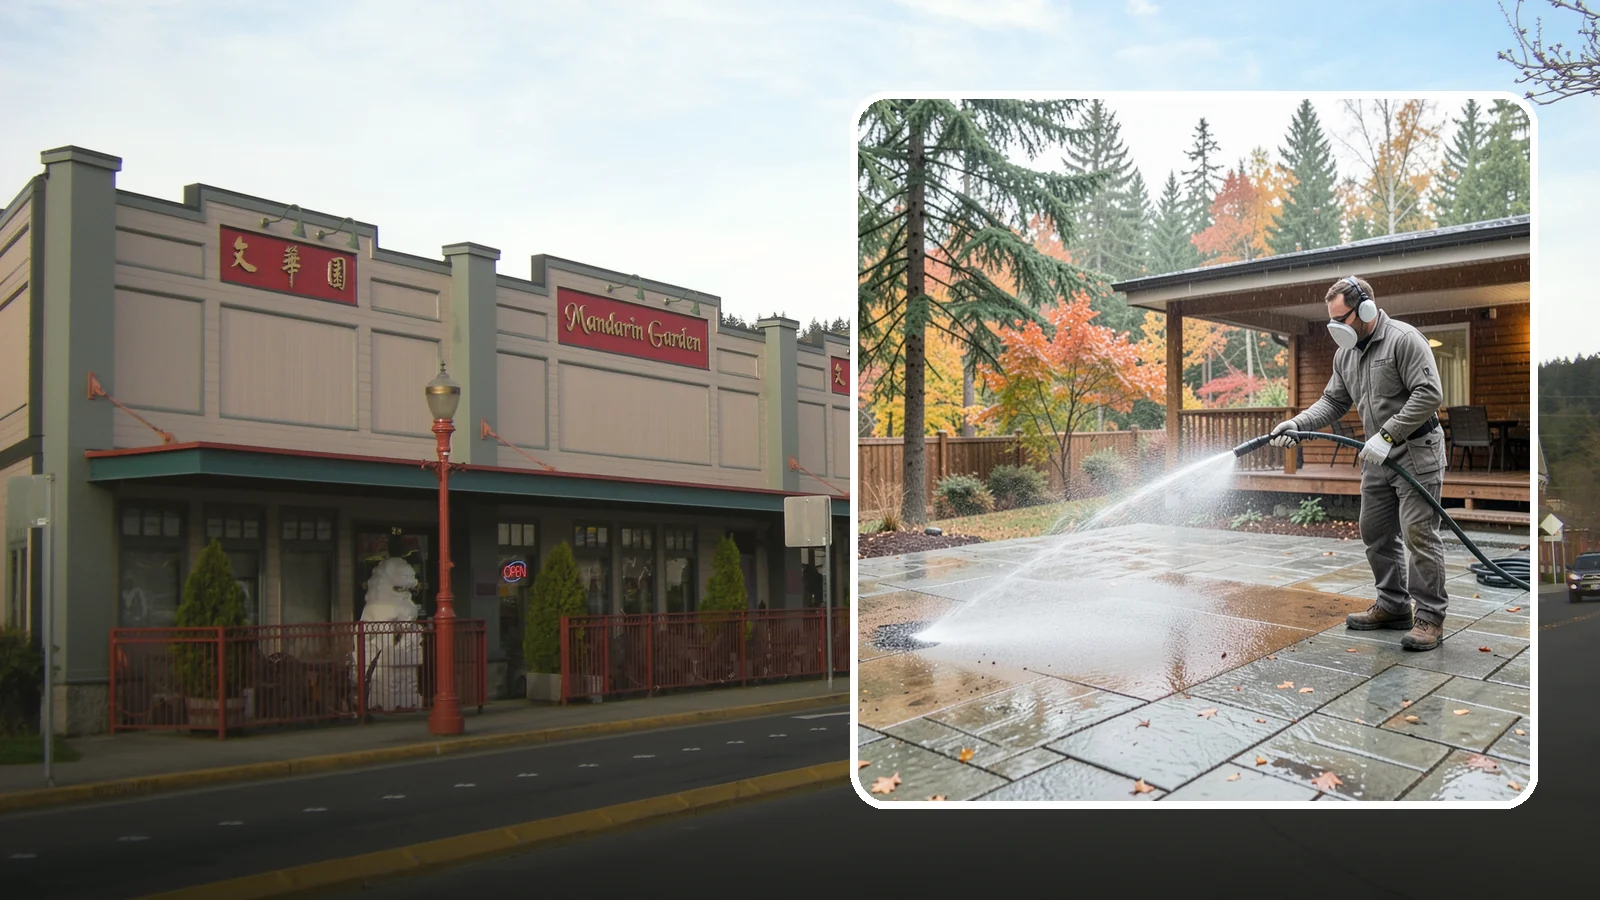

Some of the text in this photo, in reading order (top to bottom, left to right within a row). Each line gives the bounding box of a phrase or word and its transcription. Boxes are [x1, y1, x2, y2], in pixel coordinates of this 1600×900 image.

[564, 302, 701, 352] Mandarin Garden
[503, 565, 527, 578] OPEN
